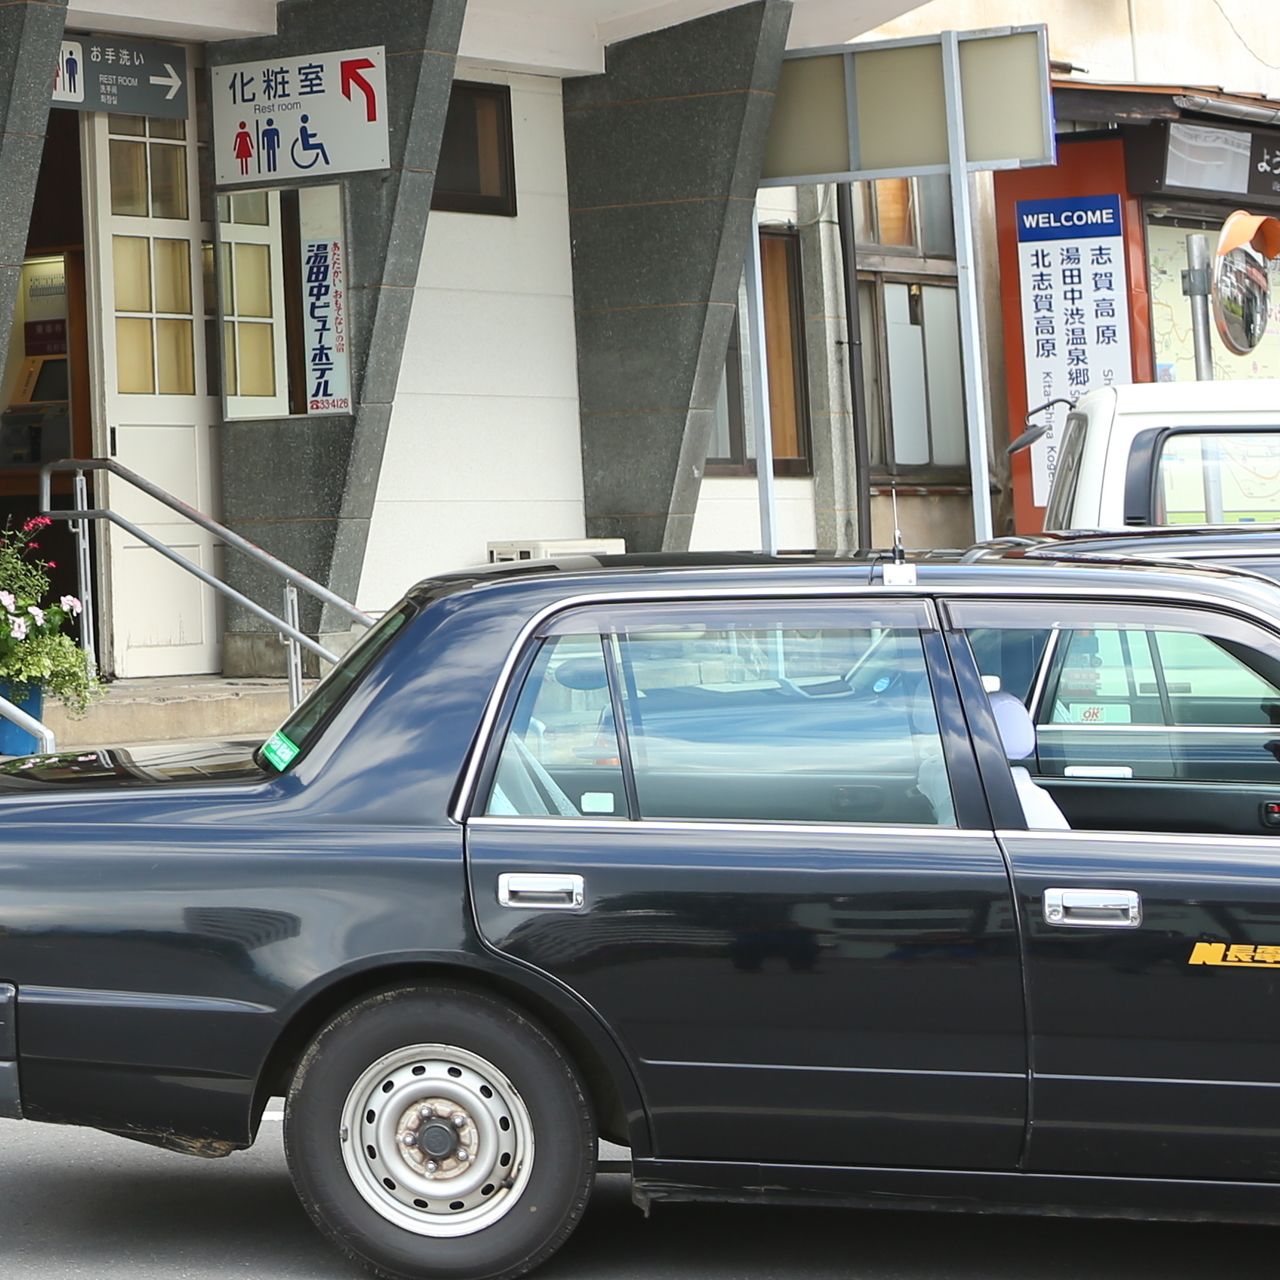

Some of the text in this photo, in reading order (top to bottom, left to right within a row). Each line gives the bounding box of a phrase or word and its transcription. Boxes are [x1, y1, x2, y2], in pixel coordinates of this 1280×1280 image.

[90, 46, 145, 66] お手洗い
[99, 74, 138, 87] REST ROOM
[228, 63, 326, 105] 化粧室
[253, 100, 302, 114] Rest room
[1023, 208, 1114, 229] WELCOME
[1030, 248, 1057, 359] 北志賀高原
[1059, 246, 1090, 387] 湯田中渋温泉郷
[1090, 245, 1119, 346] 志賀高原
[305, 243, 335, 398] 湯田中ビューホテル
